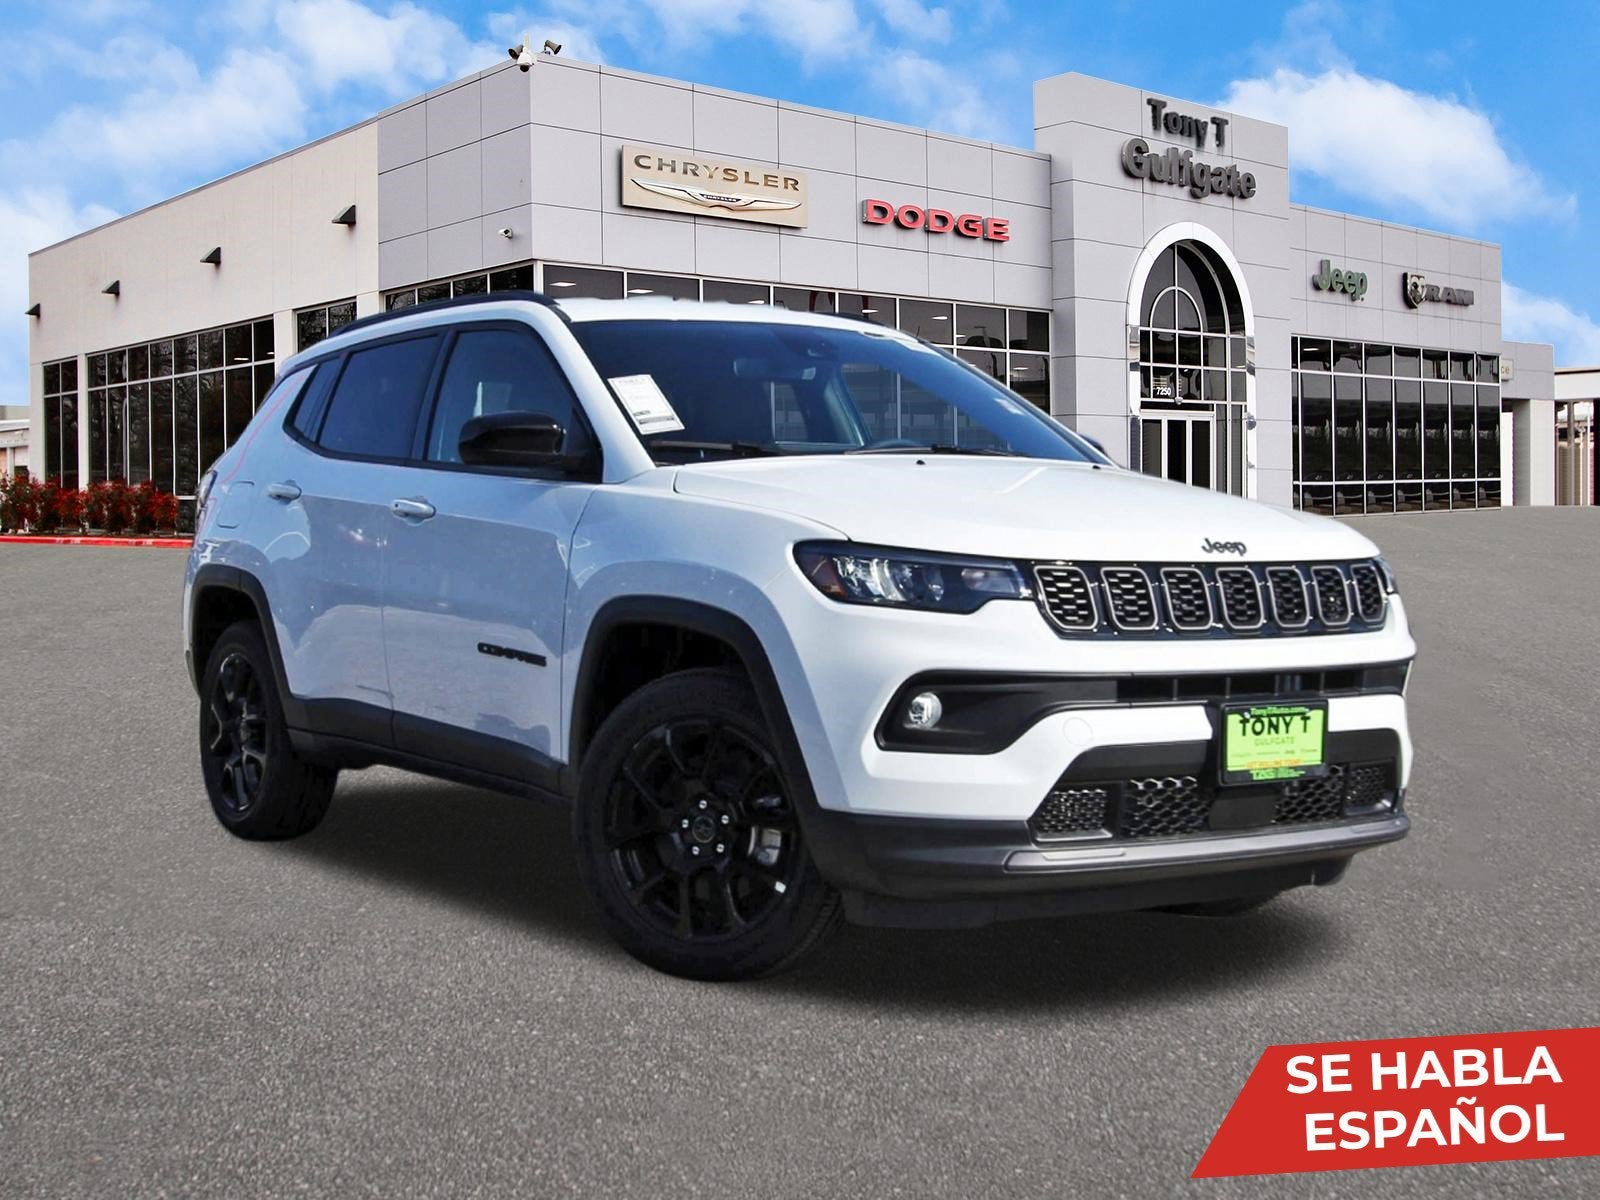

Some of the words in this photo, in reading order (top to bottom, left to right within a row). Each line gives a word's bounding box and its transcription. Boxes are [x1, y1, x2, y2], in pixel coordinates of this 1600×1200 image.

[1147, 98, 1208, 148] Tony
[1211, 116, 1229, 147] T
[633, 154, 801, 192] CHRYSLER
[1121, 137, 1256, 199] Gulfgate
[863, 198, 1011, 242] DODGE
[1312, 259, 1368, 302] Jeep
[1424, 283, 1475, 307] RAM
[1156, 386, 1172, 396] 7250
[1201, 537, 1247, 557] Jeep
[1239, 716, 1295, 737] TONY
[1300, 715, 1311, 734] T
